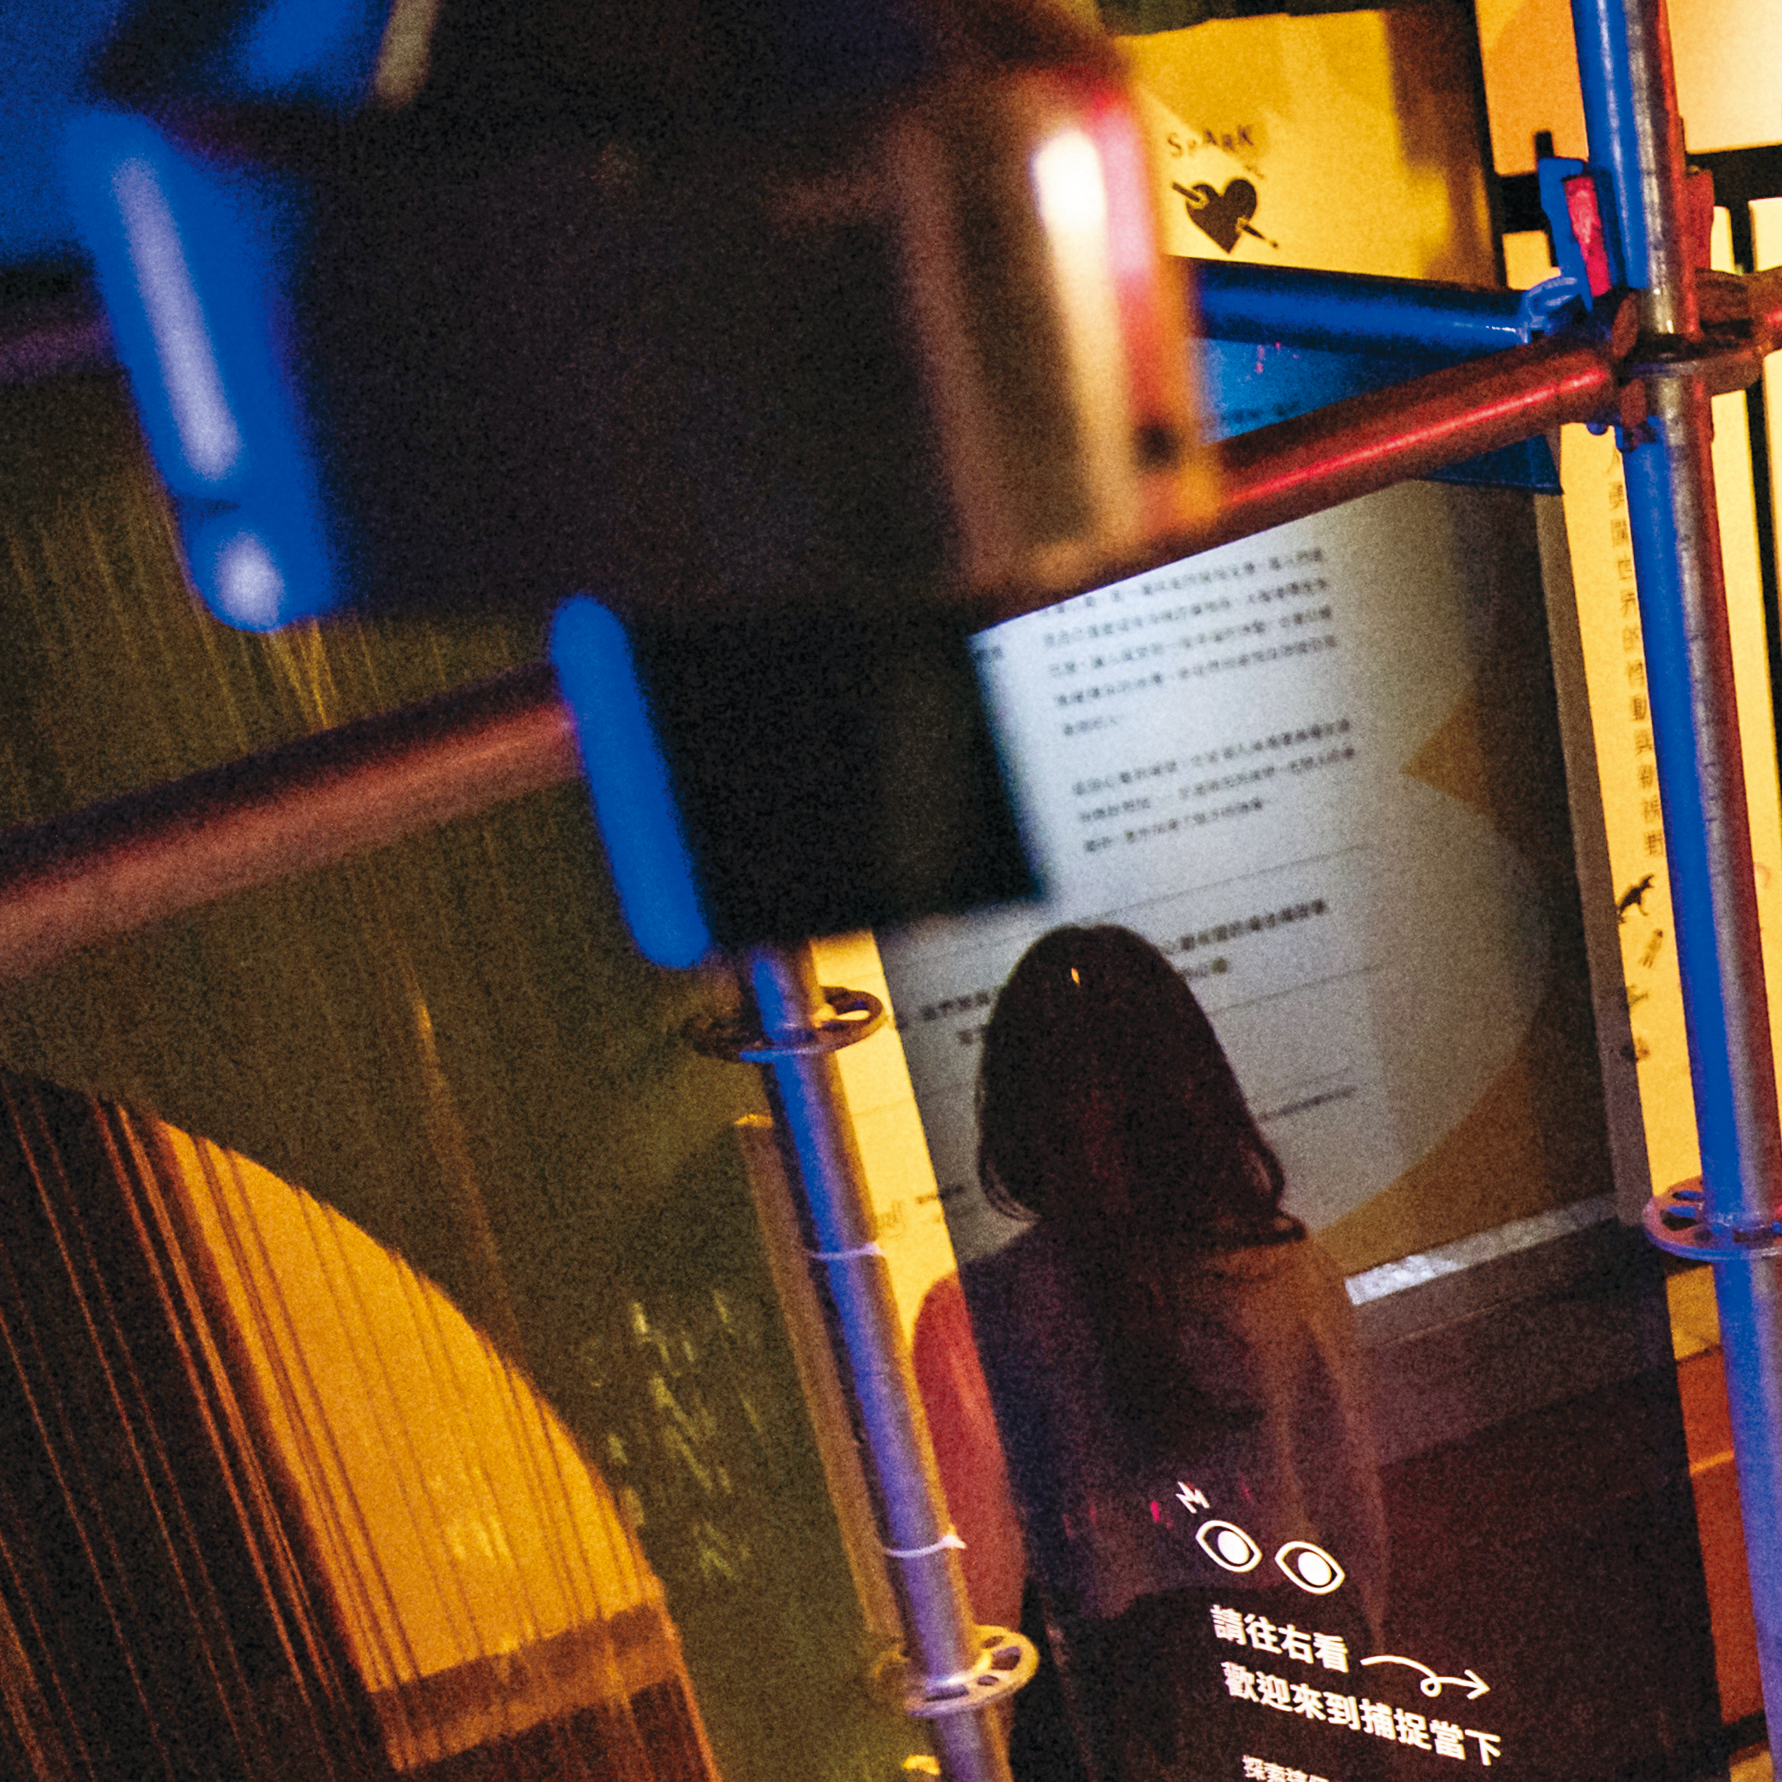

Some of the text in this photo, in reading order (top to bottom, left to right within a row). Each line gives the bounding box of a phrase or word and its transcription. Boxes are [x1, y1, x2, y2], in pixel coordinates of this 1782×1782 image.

[1209, 1603, 1349, 1674] 請往右看
[1220, 1660, 1502, 1767] 歡迎來到捕捉當下
